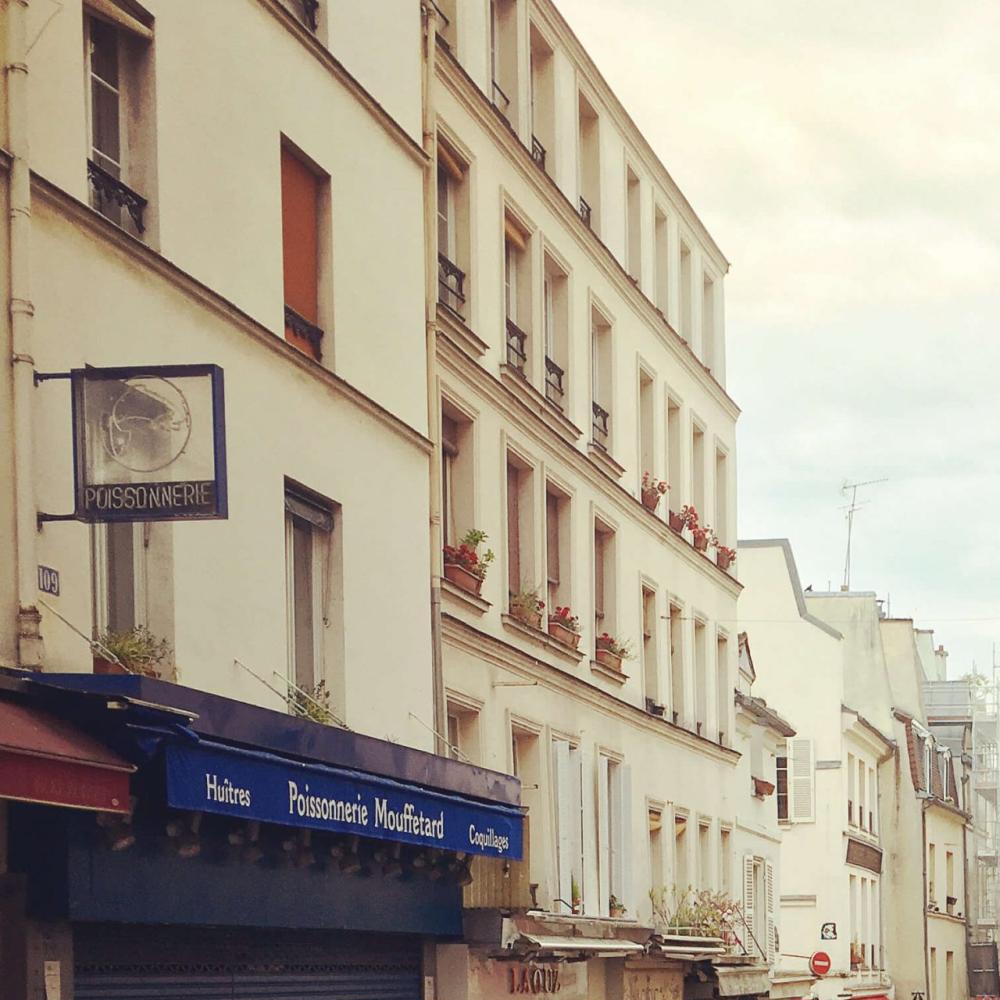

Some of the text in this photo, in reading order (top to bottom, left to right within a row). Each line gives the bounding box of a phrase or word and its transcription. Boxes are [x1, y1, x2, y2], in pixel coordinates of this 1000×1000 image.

[84, 483, 212, 511] POISSONNERIE
[38, 566, 59, 595] 109
[205, 773, 251, 807] Huîtres
[288, 780, 445, 840] Poissonnerie Mouffetard
[469, 824, 509, 854] Coquillages
